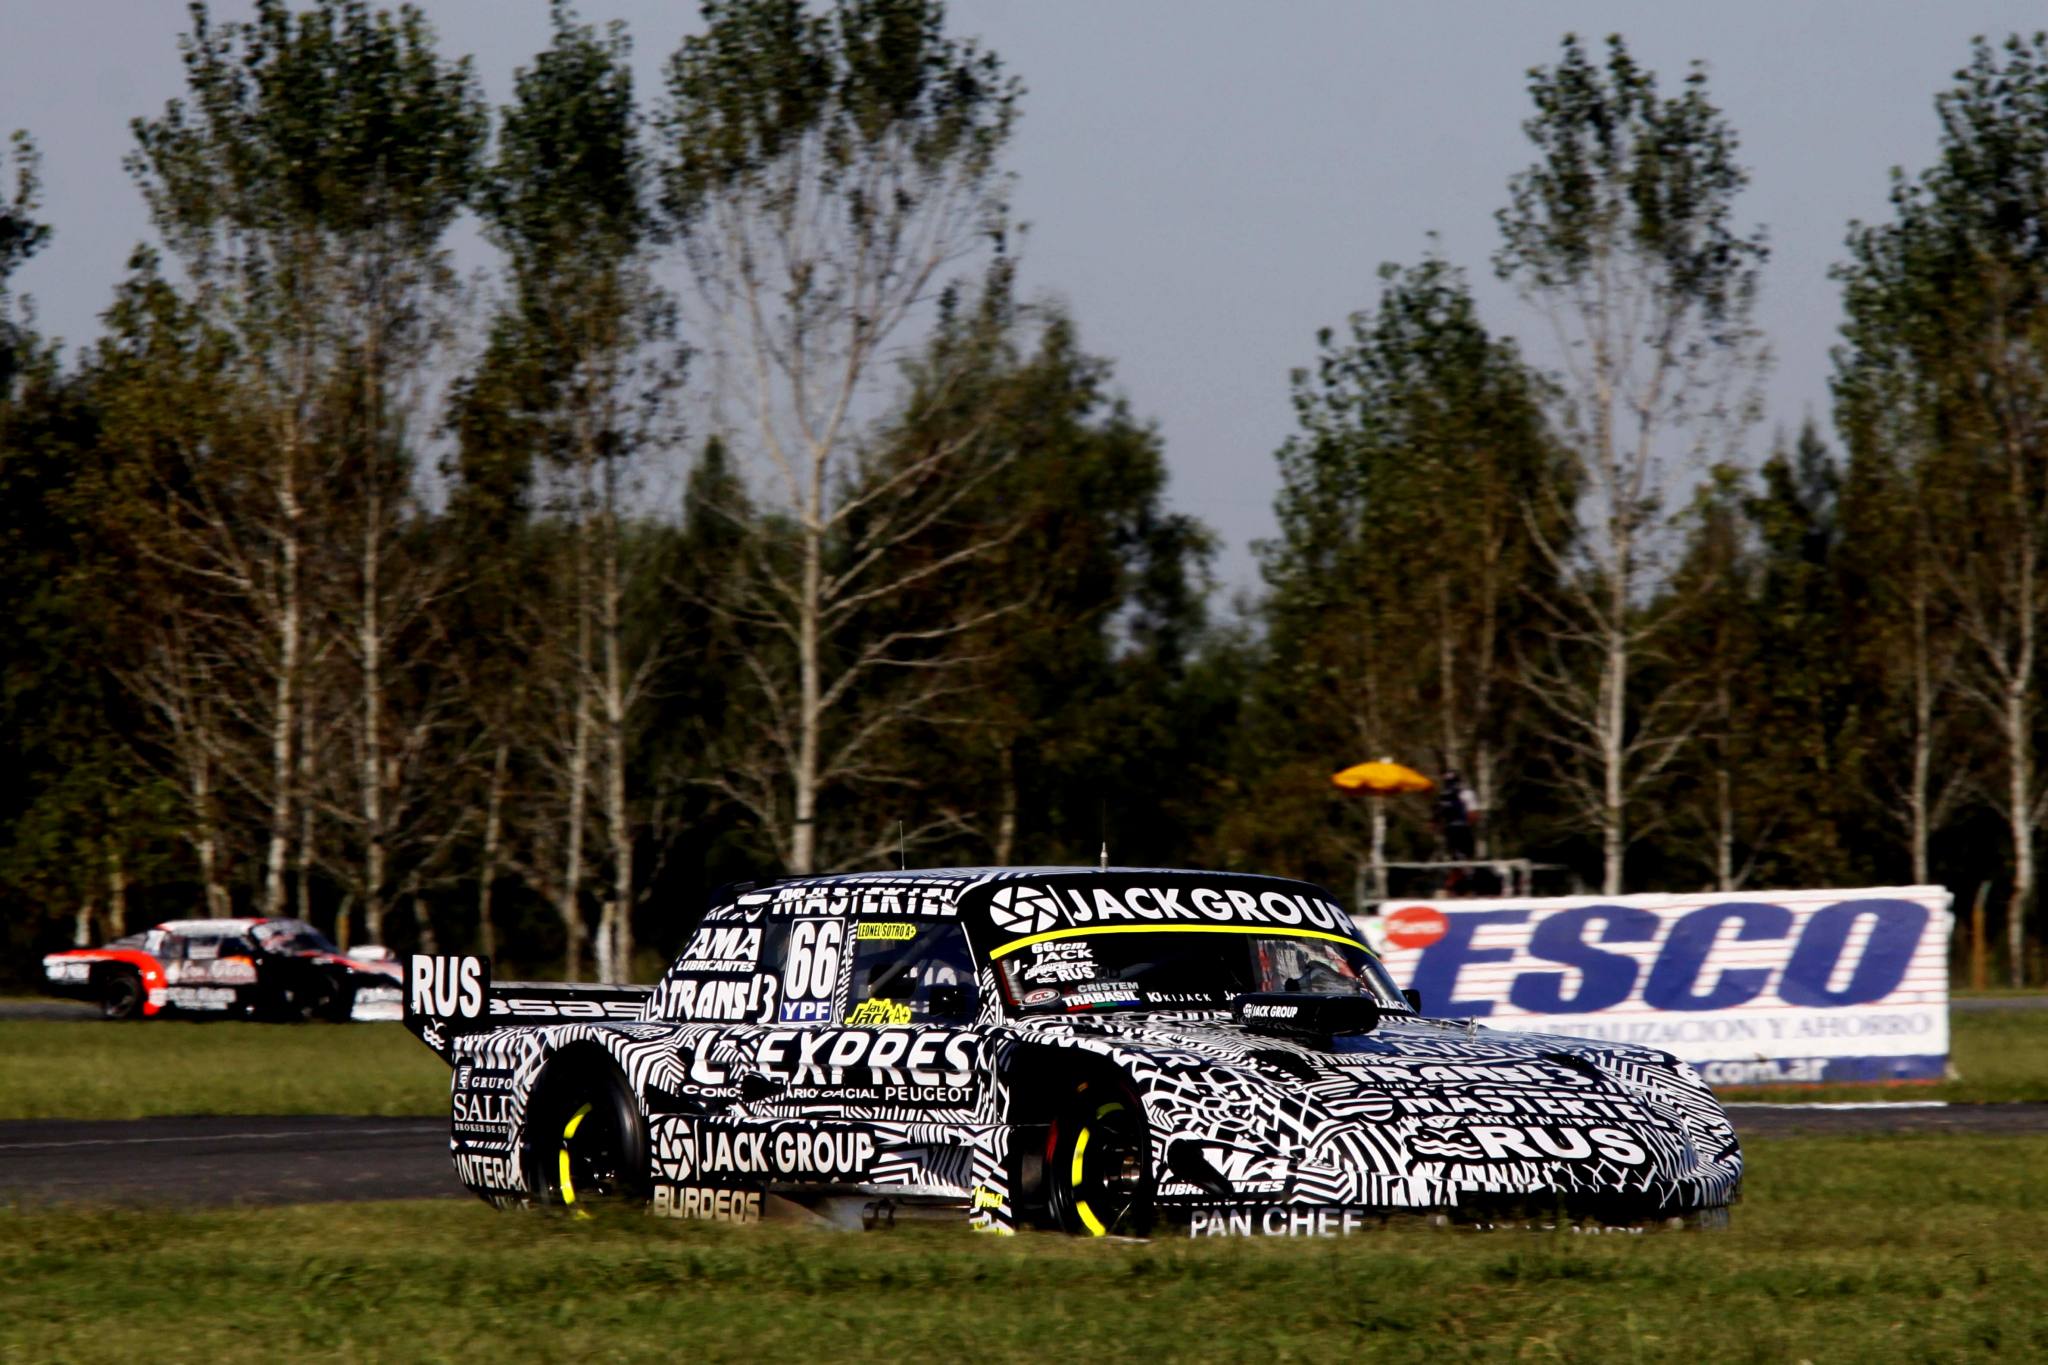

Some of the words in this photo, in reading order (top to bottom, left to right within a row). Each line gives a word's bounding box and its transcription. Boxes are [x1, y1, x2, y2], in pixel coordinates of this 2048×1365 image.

[1068, 887, 1201, 921] JACK
[1190, 888, 1352, 935] GROUP
[857, 924, 881, 937] LEONEL
[682, 928, 762, 960] AMA
[676, 960, 756, 972] LUBRICANTES
[785, 921, 841, 999] 66
[1036, 949, 1093, 967] JACK
[1413, 899, 1930, 1017] ESCO
[1056, 966, 1095, 982] RUS
[412, 954, 482, 1018] RUS
[1077, 982, 1139, 993] CRISTEM
[1062, 990, 1140, 1007] TRABASIL
[783, 1002, 831, 1020] YPF
[1253, 1004, 1270, 1018] JACK
[1270, 1005, 1298, 1018] GROUP
[1767, 1018, 1788, 1040] Y
[471, 1076, 513, 1090] GRUPO
[885, 1086, 973, 1102] PEUGEOT
[455, 1124, 484, 1132] BROKER
[485, 1124, 496, 1133] DE
[701, 1132, 769, 1173] JACK
[775, 1131, 875, 1173] GROUP
[1467, 1126, 1646, 1165] RUS
[1190, 1208, 1251, 1239] PAN
[1262, 1207, 1364, 1238] CHEF
